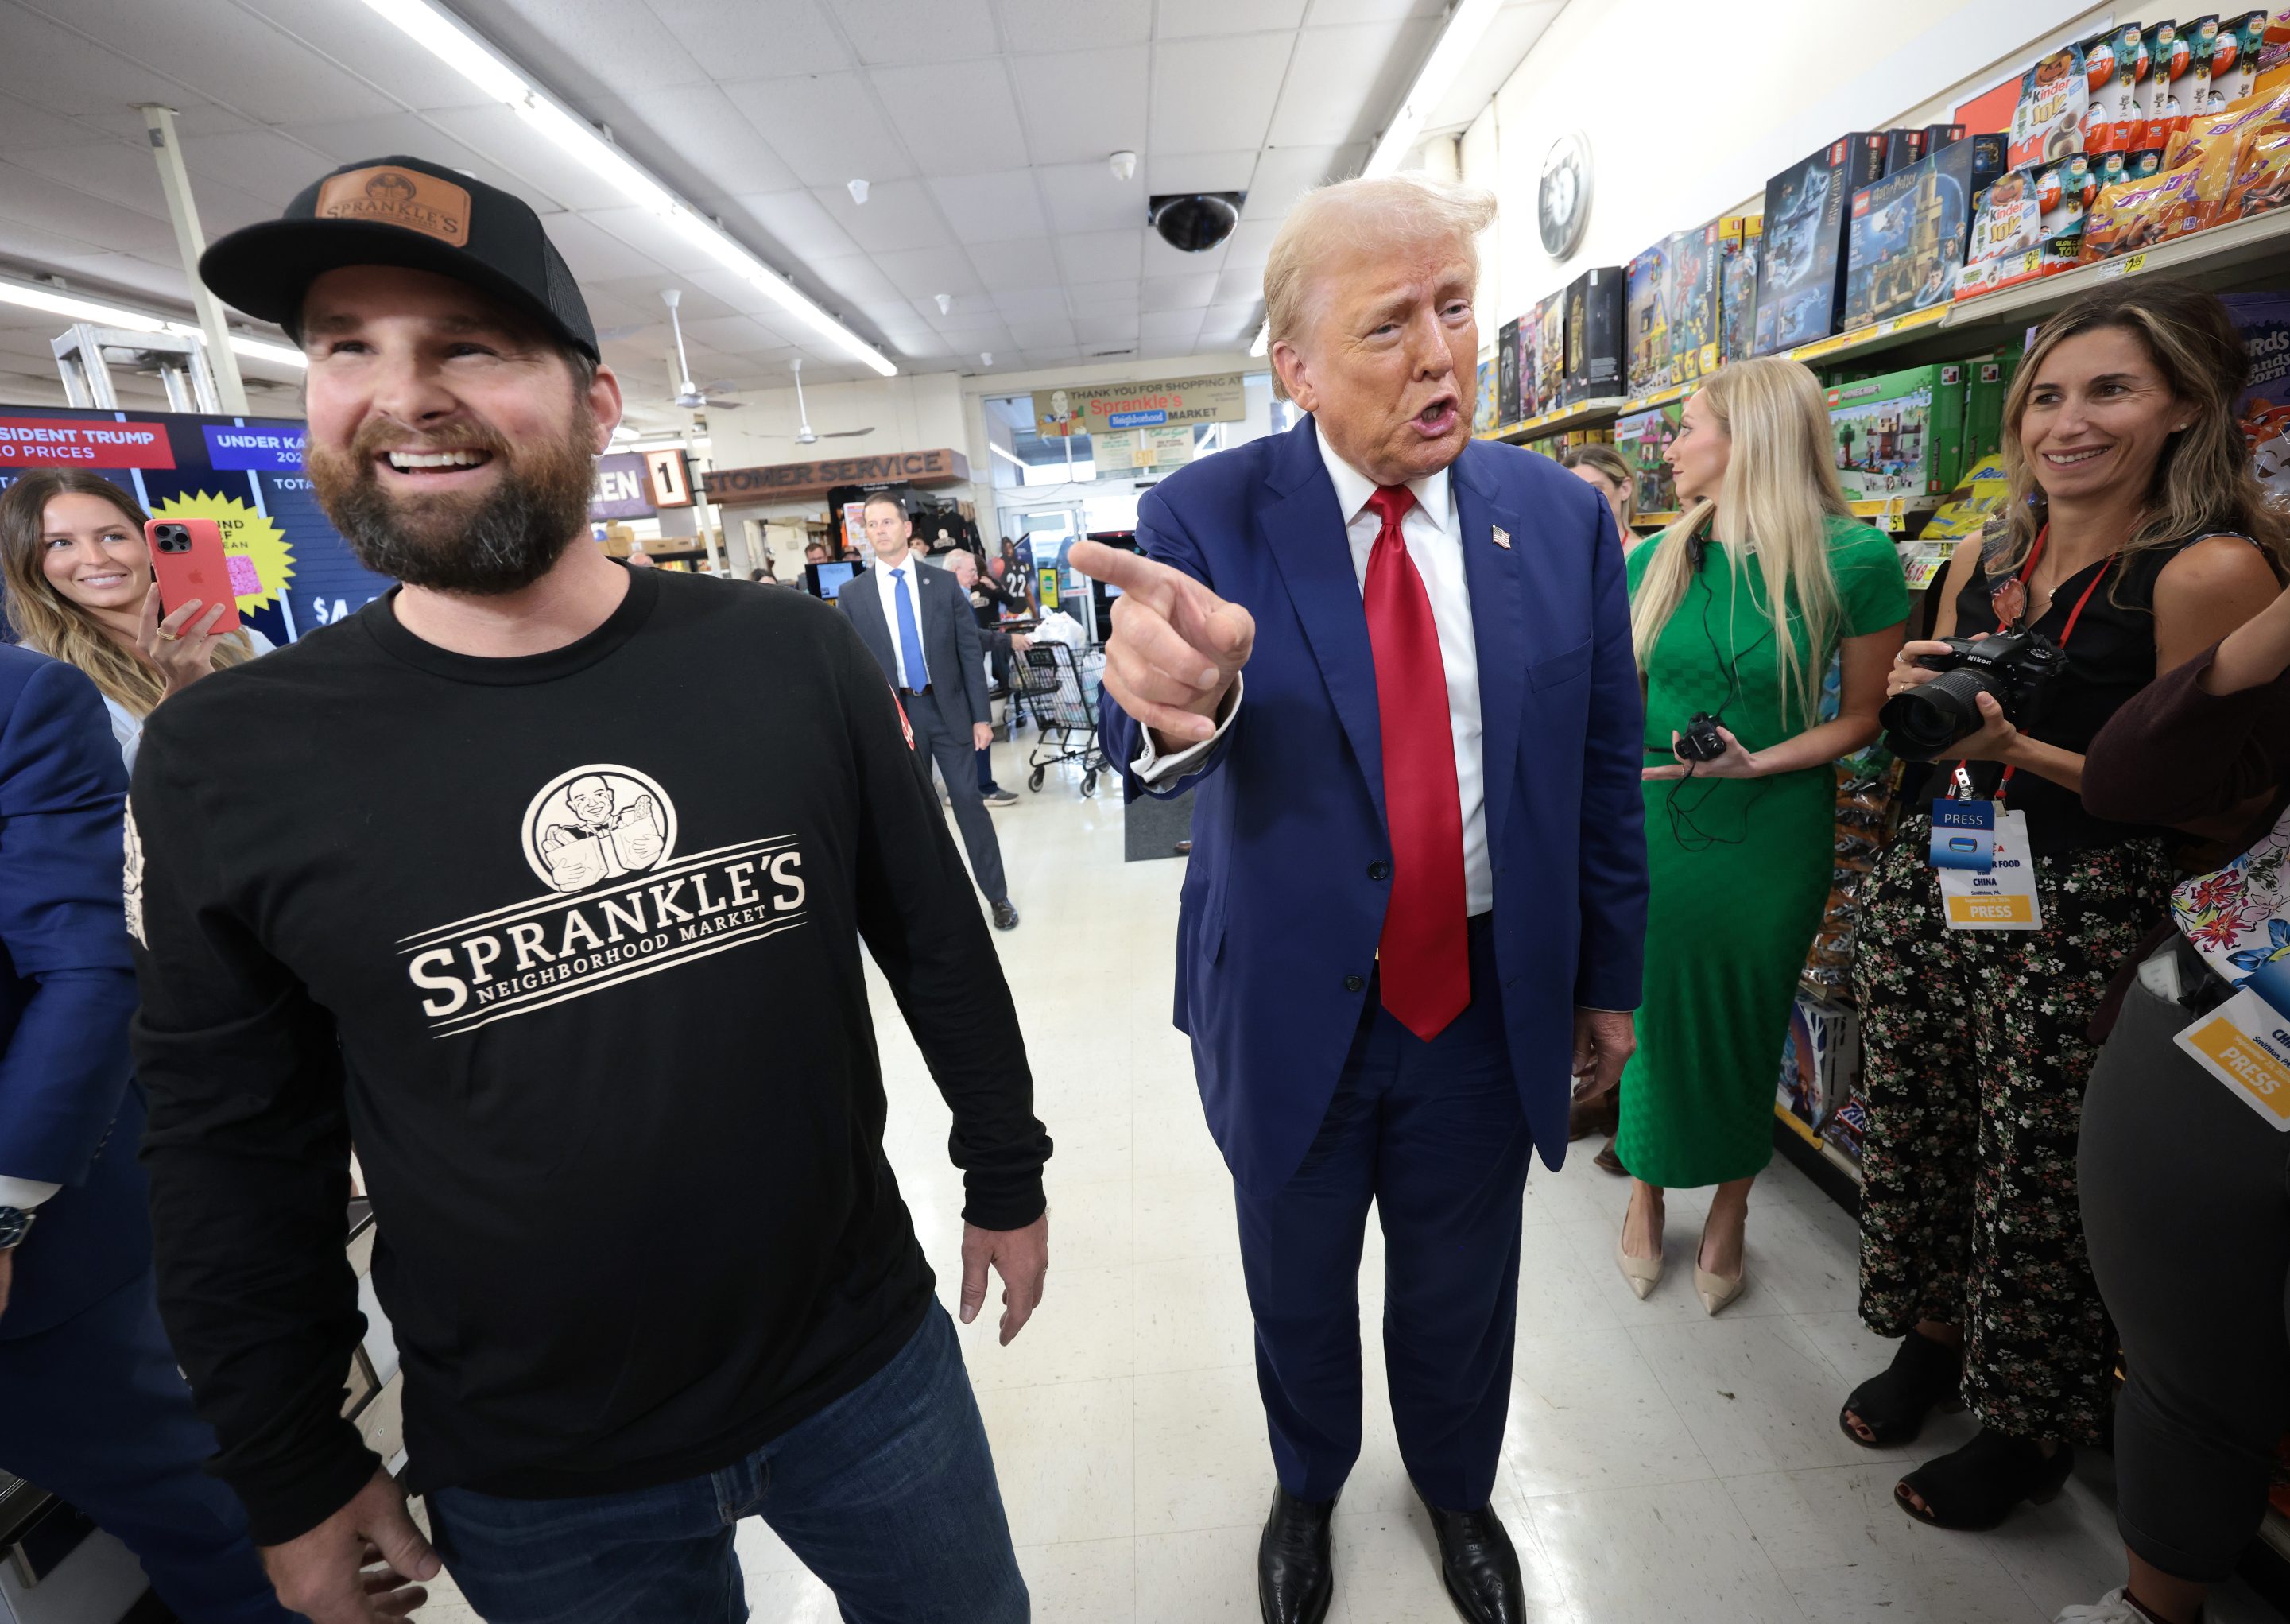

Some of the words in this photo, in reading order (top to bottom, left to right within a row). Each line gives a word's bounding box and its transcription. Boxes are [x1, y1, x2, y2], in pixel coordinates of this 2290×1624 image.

[2031, 93, 2067, 126] JOY
[1990, 215, 2021, 243] JOY
[2059, 247, 2080, 258] TOY
[1071, 390, 1111, 401] THANK
[1114, 386, 1137, 397] YOU
[1139, 383, 1164, 393] FOR
[1165, 378, 1226, 392] SHOPPING
[1228, 375, 1243, 386] AT
[1091, 392, 1184, 417] Sprankle's
[1168, 407, 1218, 421] MARKET
[82, 429, 155, 445] TRUMP
[216, 435, 281, 448] UNDER
[0, 445, 15, 457] 0
[23, 445, 95, 459] PRICES
[657, 462, 674, 494] 1
[818, 451, 944, 482] SERVICE
[595, 470, 641, 502] EN
[1006, 572, 1026, 598] 22
[1966, 654, 1993, 666] Nikon
[1944, 813, 1983, 826] PRESS
[1999, 859, 2021, 868] FOOD
[1973, 878, 1997, 886] CHINA
[1970, 905, 2013, 918] PRESS
[408, 851, 806, 1017] SPRANKLE'S
[475, 933, 669, 1006] NEIGHBORHOOD
[680, 904, 767, 942] MARKET
[2233, 1035, 2265, 1060] September
[2253, 1036, 2281, 1060] Smithton,
[2218, 1046, 2280, 1095] PRESS
